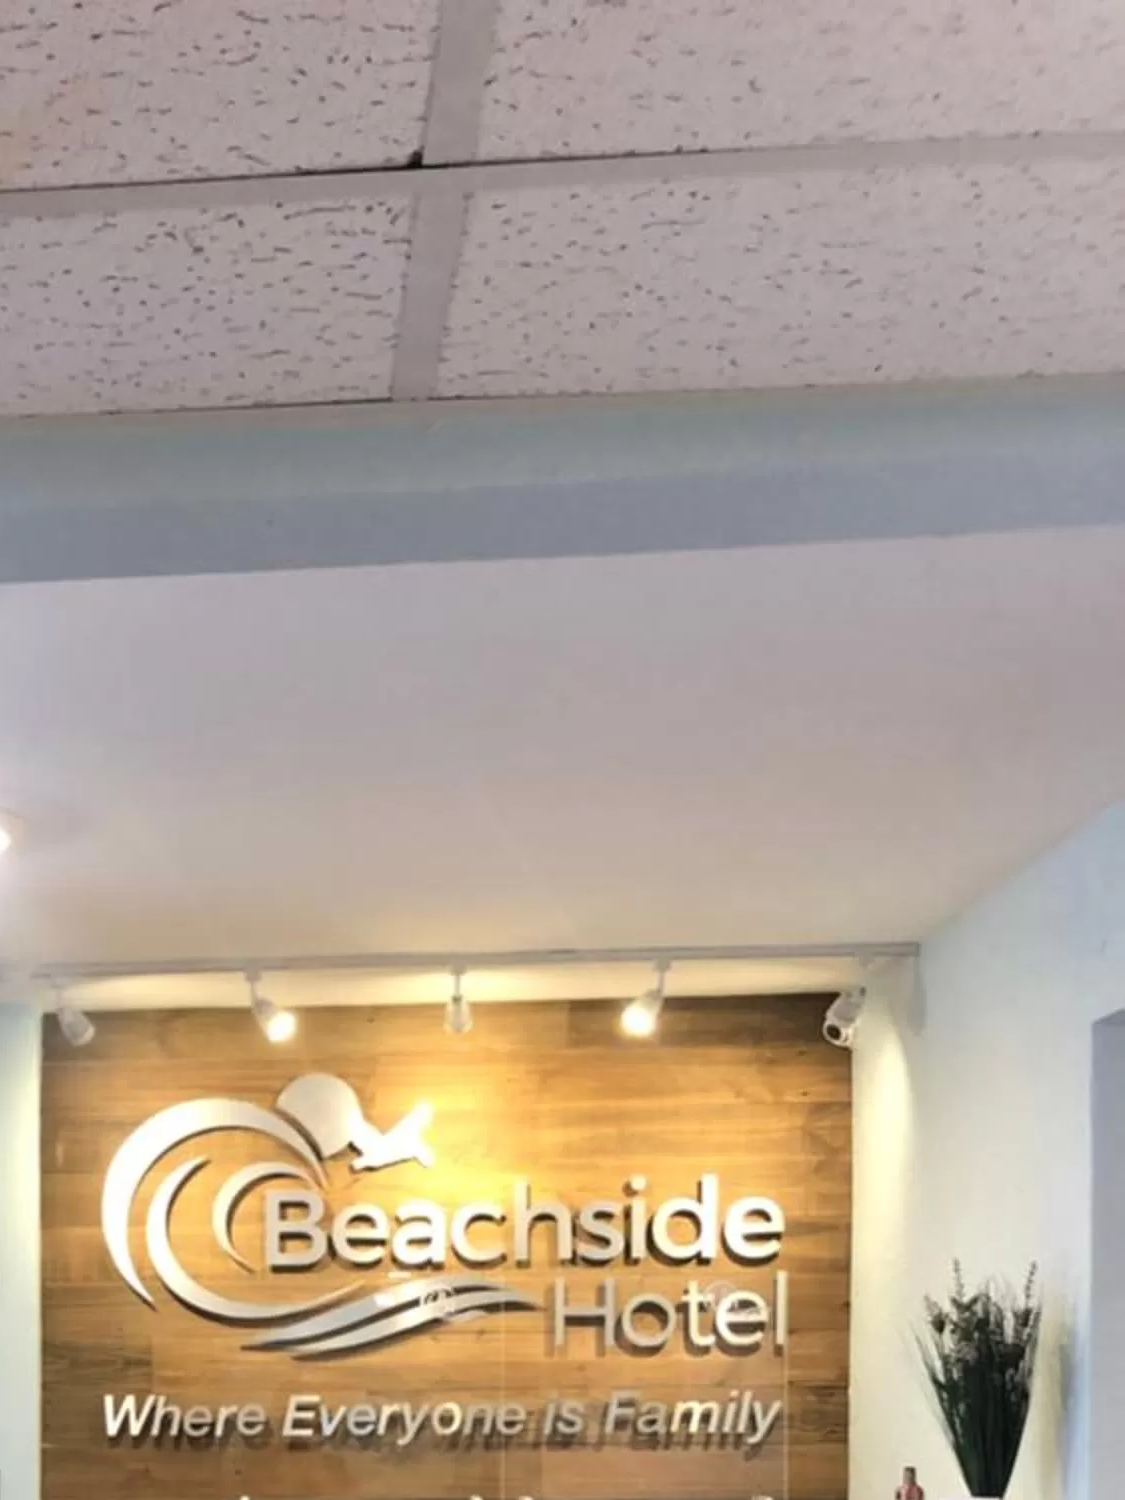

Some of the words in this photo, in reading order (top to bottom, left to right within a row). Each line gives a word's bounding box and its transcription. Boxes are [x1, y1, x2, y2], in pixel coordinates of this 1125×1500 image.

[265, 1173, 785, 1266] Beachside
[554, 1271, 787, 1348] Hotel
[103, 1394, 266, 1437] Where
[282, 1394, 525, 1445] Everyone
[543, 1391, 586, 1435] is
[604, 1390, 782, 1444] Family
